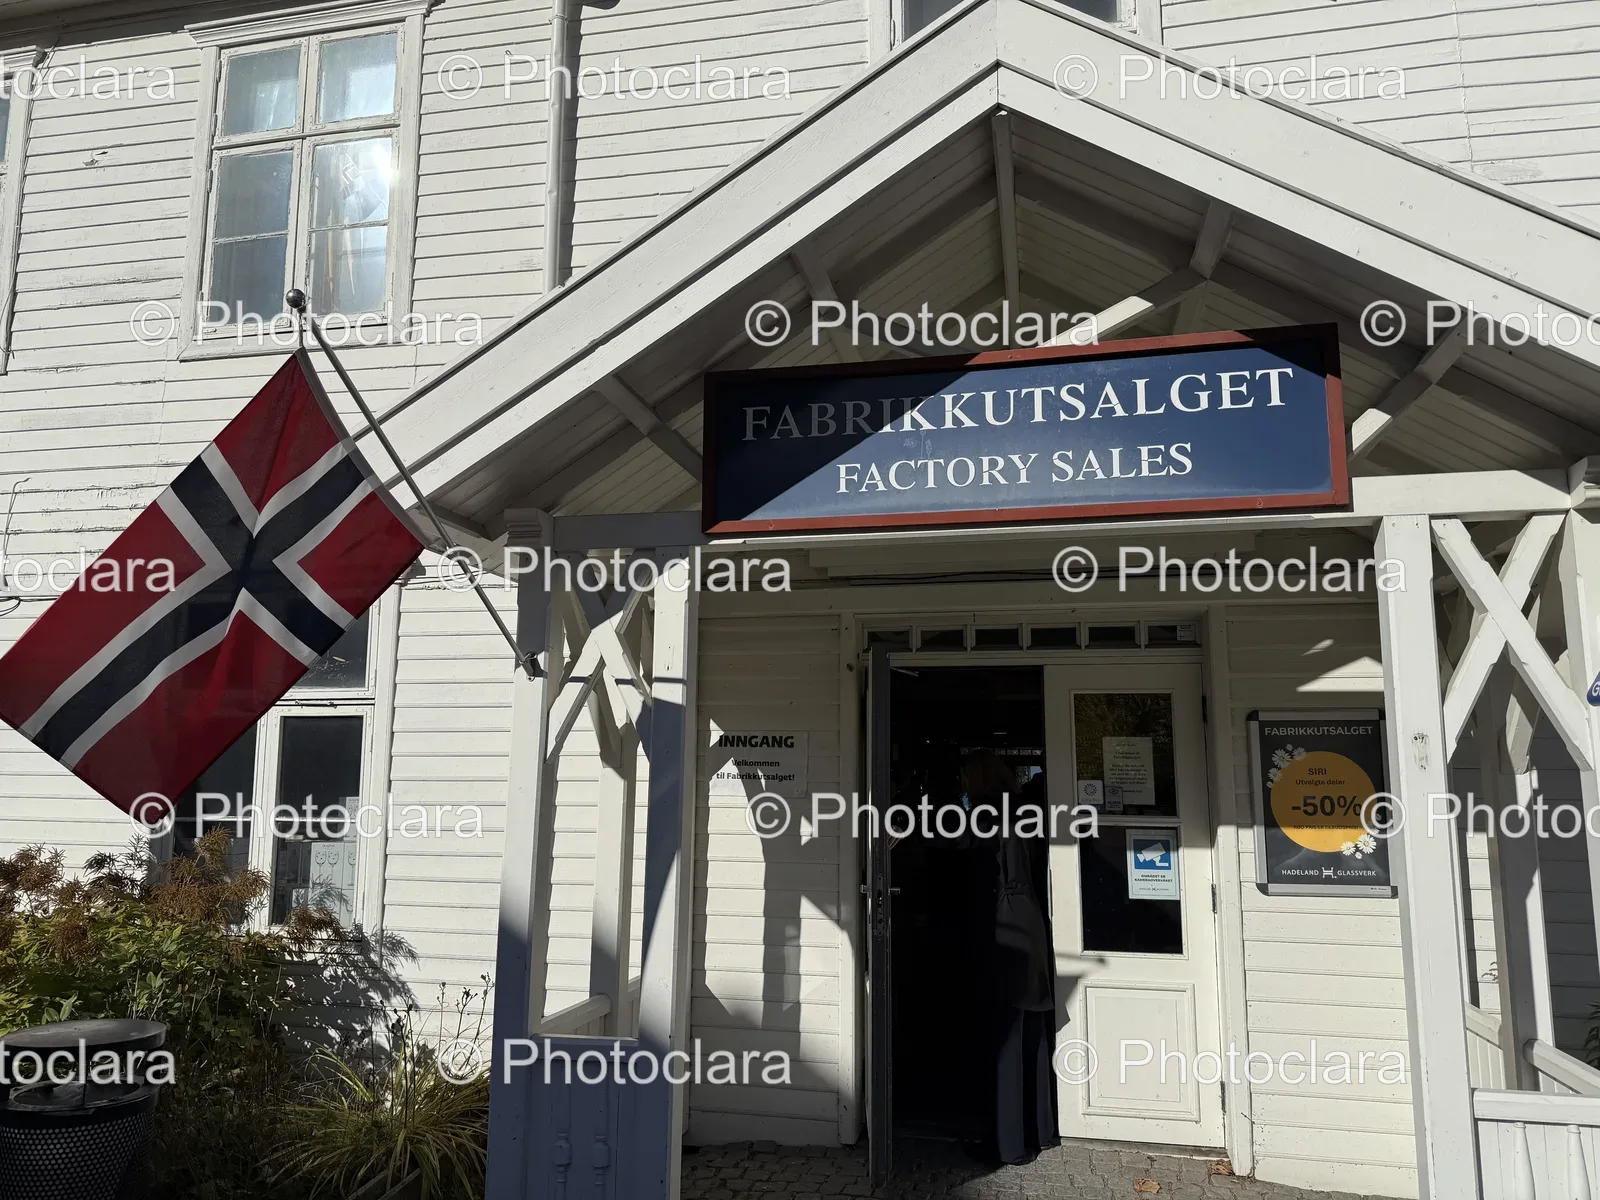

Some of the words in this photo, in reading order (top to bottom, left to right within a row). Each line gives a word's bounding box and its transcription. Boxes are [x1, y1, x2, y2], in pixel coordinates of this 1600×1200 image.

[742, 367, 1294, 441] FABRIKKUTSALGET
[836, 452, 1039, 494] FACTORY
[1052, 442, 1193, 483] SALES
[1264, 726, 1373, 736] FABRIKKUTSALGET
[718, 735, 795, 748] INNGANG
[716, 772, 725, 780] til
[726, 773, 795, 782] Fabrikkutsalget!
[1308, 768, 1327, 776] SIRI
[1295, 779, 1326, 787] Utvalgte
[1291, 795, 1364, 817] -50%
